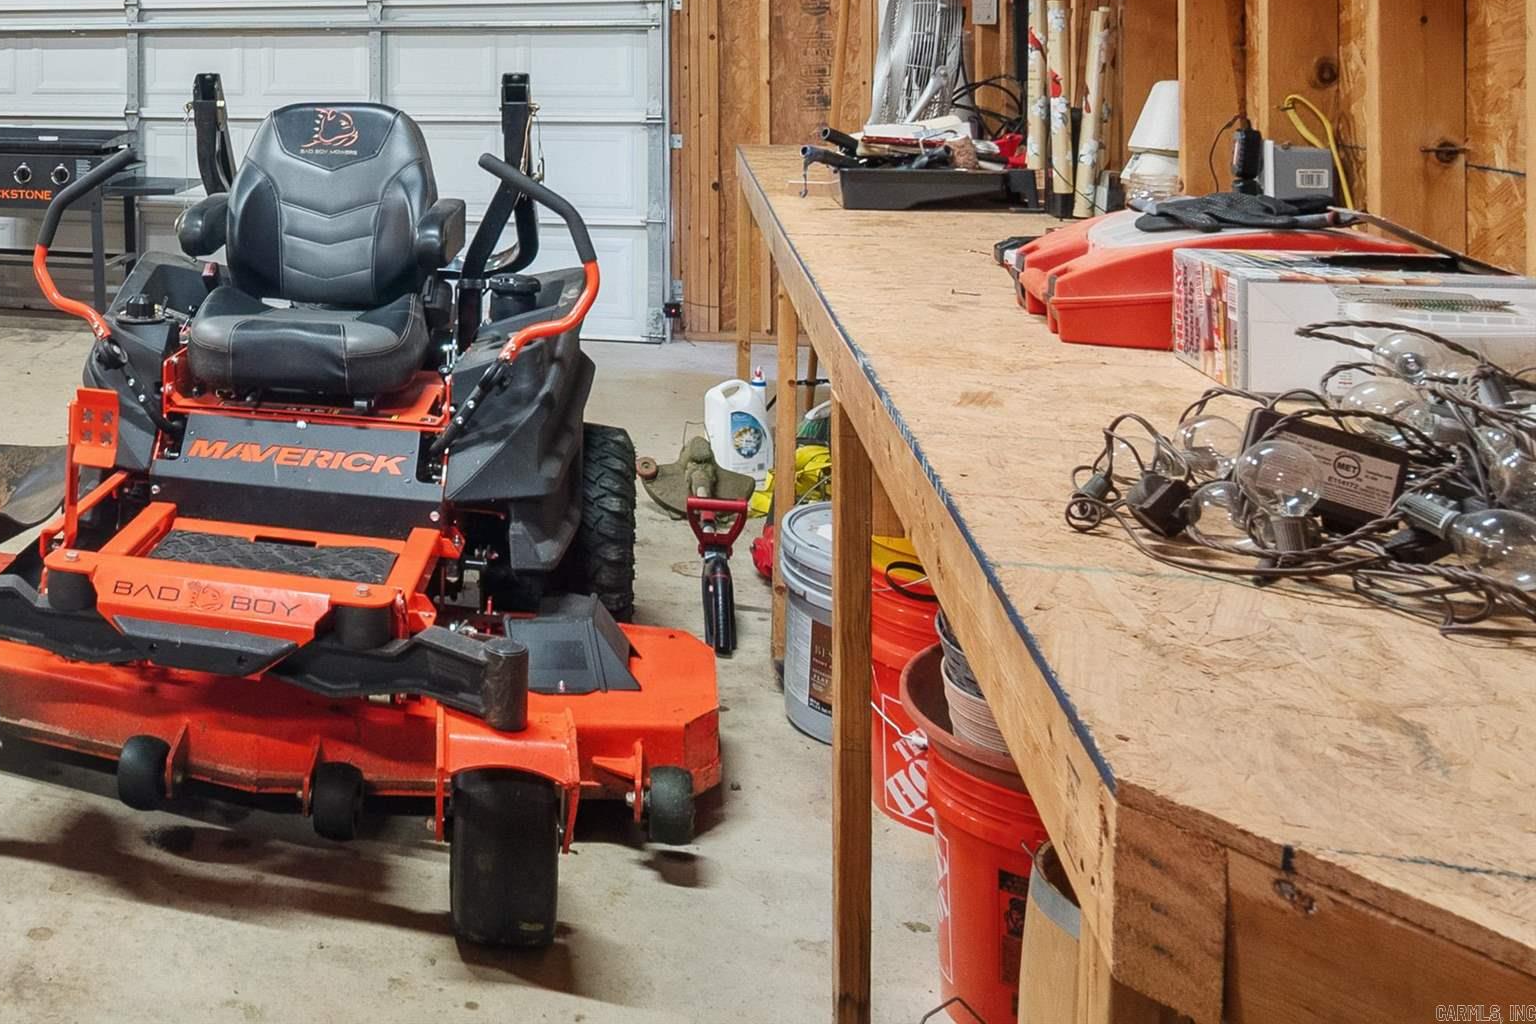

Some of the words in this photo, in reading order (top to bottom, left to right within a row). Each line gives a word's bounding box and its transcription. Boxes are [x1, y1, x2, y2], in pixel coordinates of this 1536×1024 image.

[1175, 264, 1185, 353] HUSKY
[187, 439, 408, 476] MAVERICK
[1336, 460, 1359, 474] MET
[113, 580, 180, 602] BAD
[230, 595, 302, 616] BOY
[886, 759, 928, 816] HO
